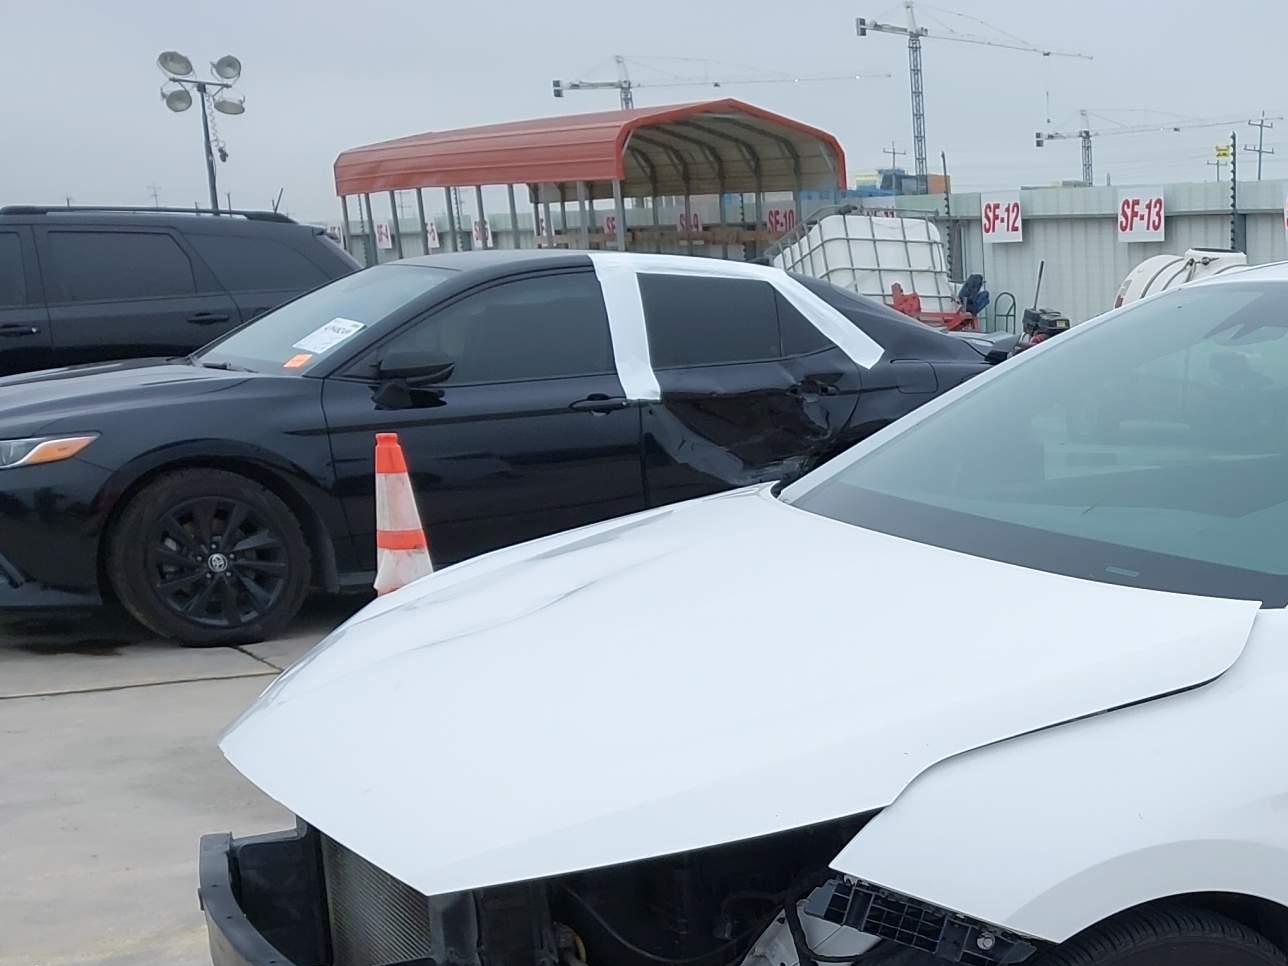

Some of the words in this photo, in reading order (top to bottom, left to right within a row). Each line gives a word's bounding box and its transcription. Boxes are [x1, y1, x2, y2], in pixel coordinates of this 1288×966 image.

[767, 209, 795, 232] SF-10
[983, 203, 1019, 232] SF-12
[1119, 199, 1163, 231] SF-13
